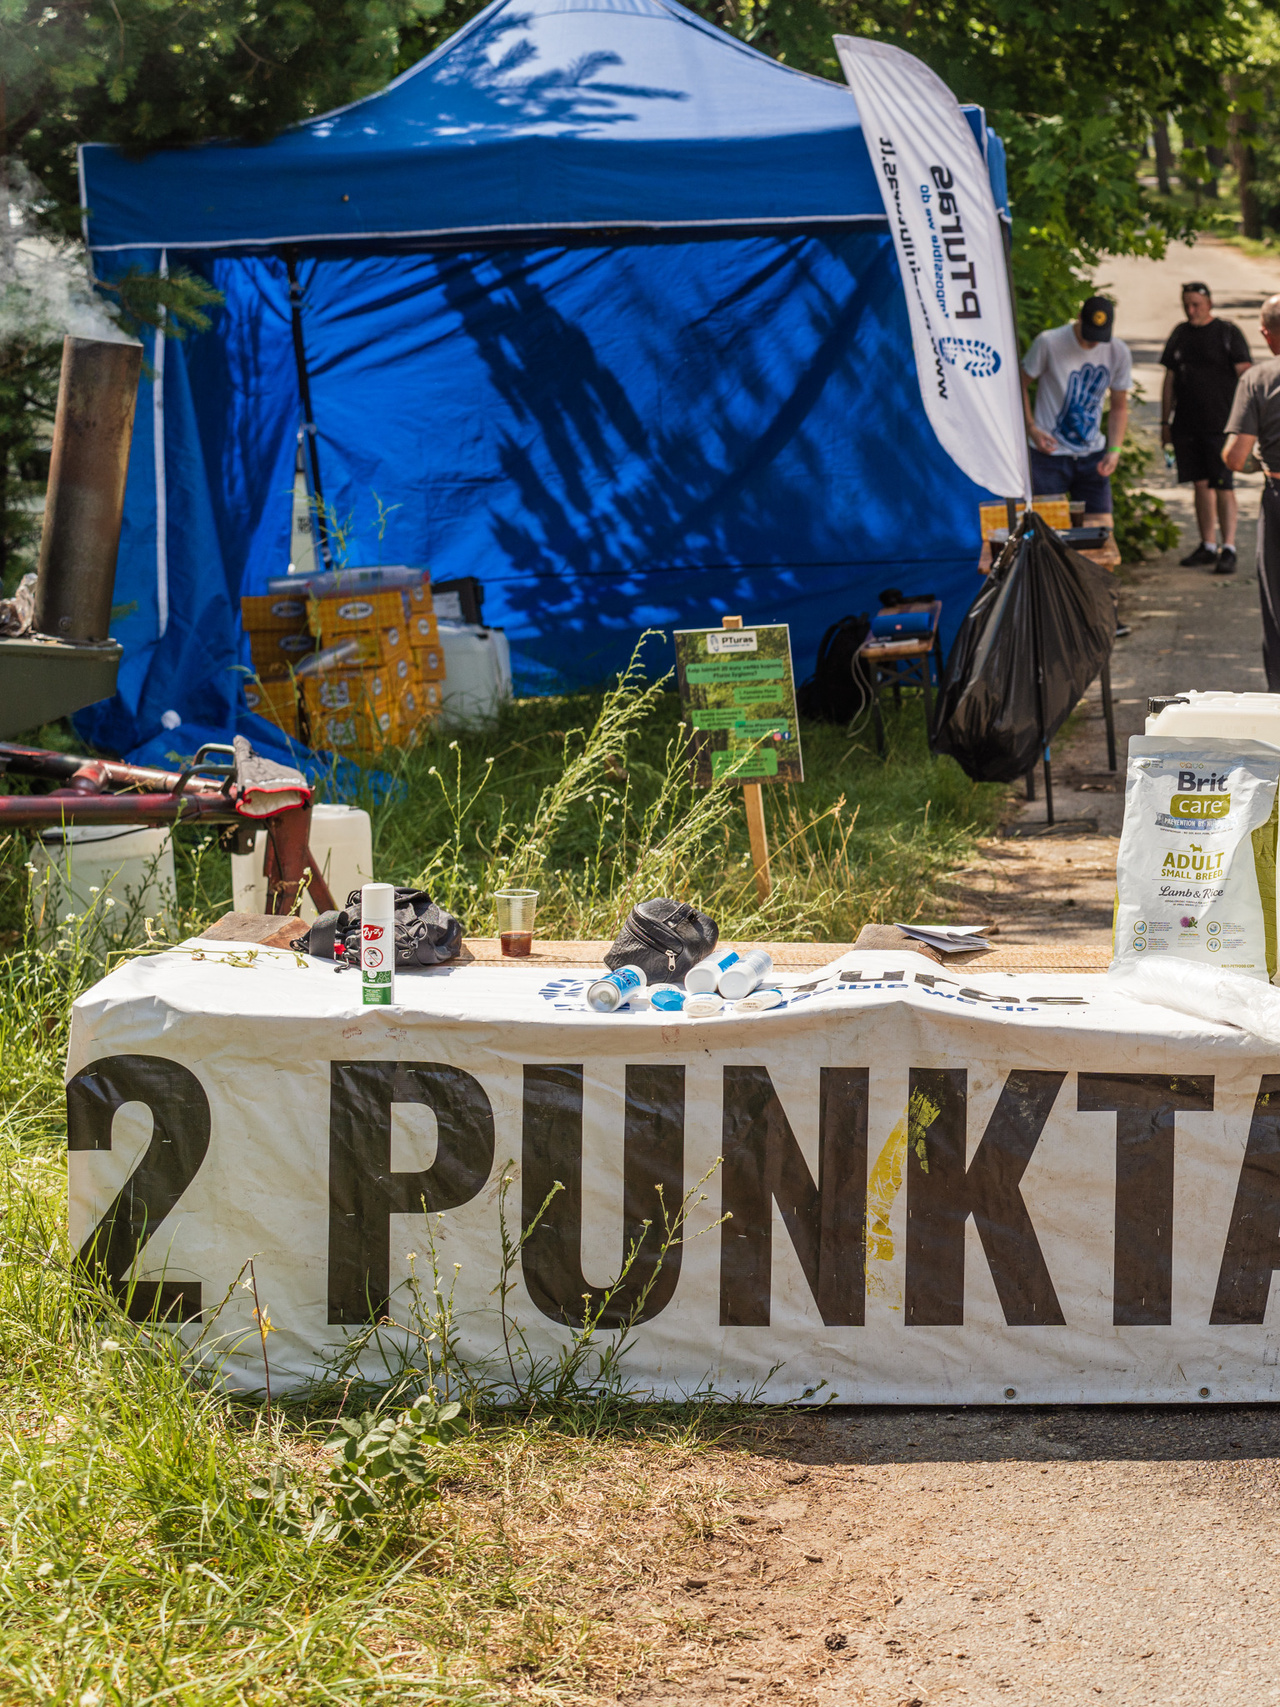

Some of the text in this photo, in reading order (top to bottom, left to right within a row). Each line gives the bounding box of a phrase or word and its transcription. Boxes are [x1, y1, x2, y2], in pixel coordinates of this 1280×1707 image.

[721, 636, 754, 644] PTuras
[1177, 771, 1228, 792] Brit
[1178, 799, 1223, 814] care
[1162, 852, 1225, 871] ADULT
[1161, 868, 1223, 881] SMALL BREED
[1158, 885, 1224, 899] Lamb & Rice
[66, 1054, 211, 1324] 2
